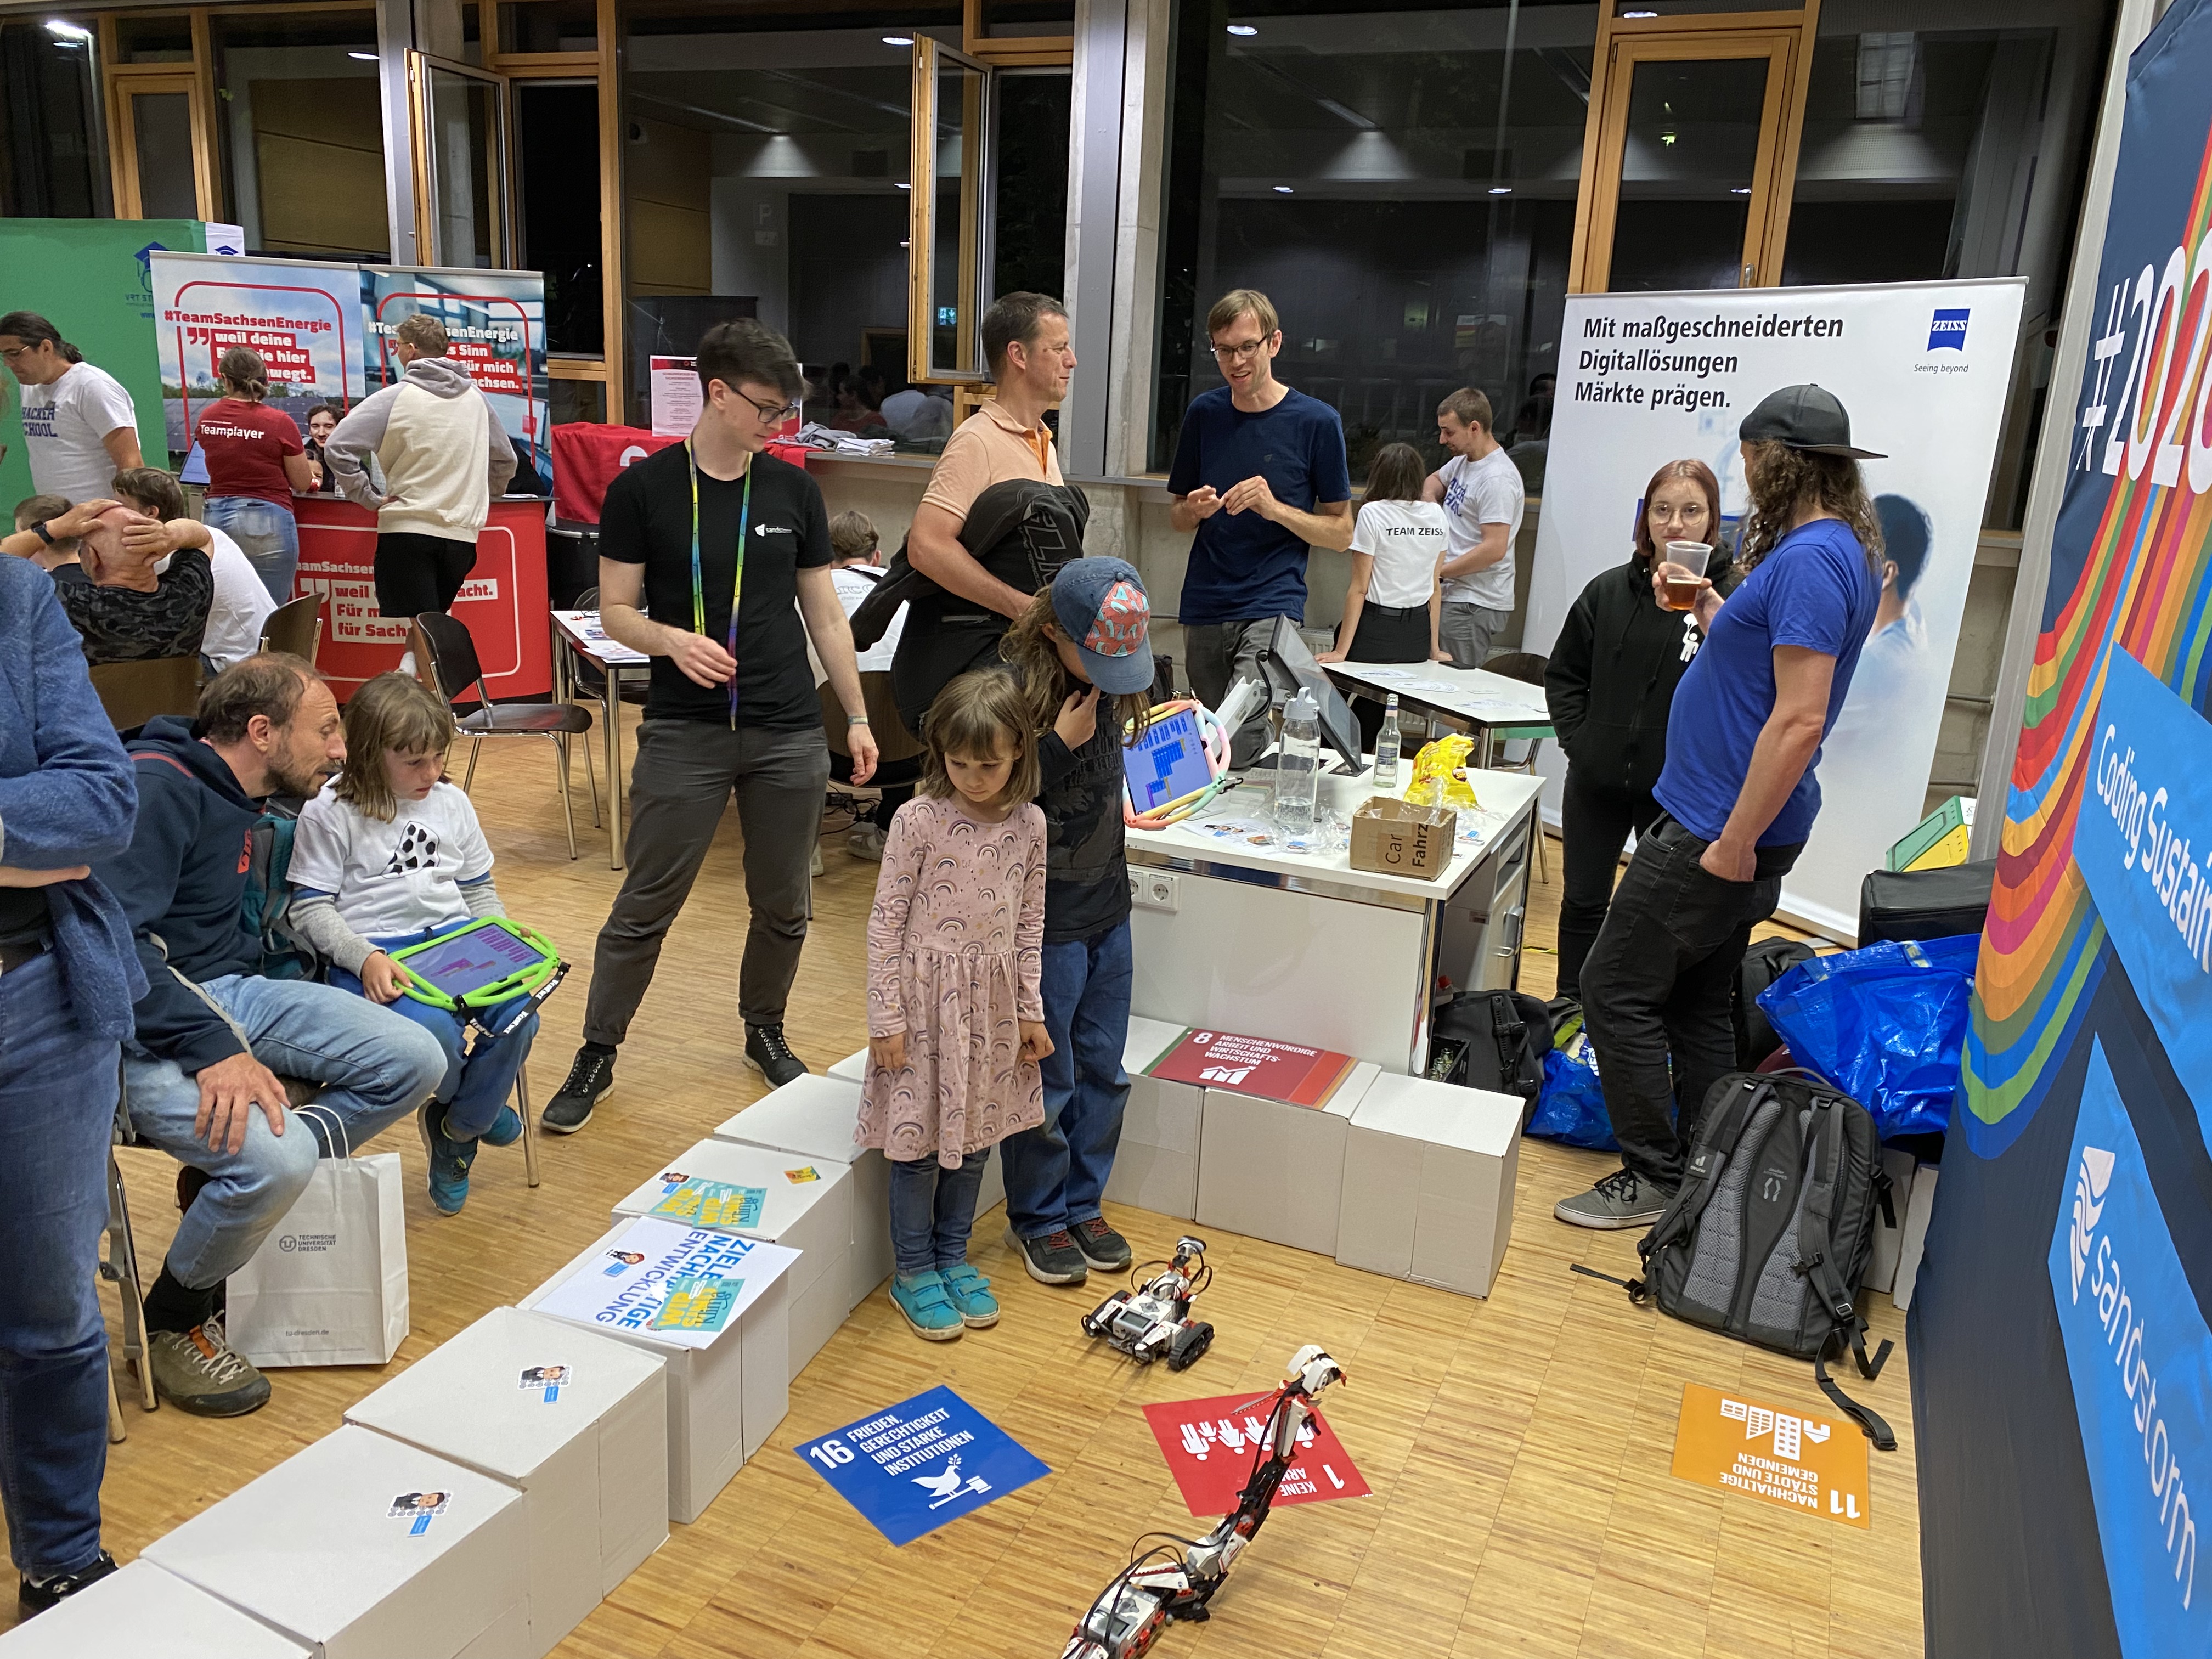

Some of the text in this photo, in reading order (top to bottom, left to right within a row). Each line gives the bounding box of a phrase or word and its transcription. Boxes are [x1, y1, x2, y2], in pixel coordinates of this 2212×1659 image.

[164, 310, 331, 332] #TeamSachsenEnergie
[368, 321, 518, 342] #TeasenEnergie
[1584, 314, 1843, 345] Mit maßgeschneiderten
[1933, 319, 1967, 332] ZEISS
[215, 331, 292, 346] weil deine
[276, 350, 306, 364] hier
[459, 344, 488, 357] Sinn
[483, 360, 514, 374] mich
[1579, 350, 1738, 378] Digitallösungen
[1914, 364, 1968, 374] Seeing beyond
[473, 376, 520, 390] achsen.
[1575, 382, 1730, 412] Märkte prägen.
[22, 422, 58, 437] CHOOL
[200, 425, 264, 439] Teamplayer
[1386, 527, 1443, 536] TEAM ZEISS
[335, 585, 369, 599] weil
[457, 583, 493, 598] acht.
[337, 603, 363, 617] Für
[338, 622, 361, 636] für
[2097, 724, 2147, 870] Coding
[1385, 834, 1402, 864] Car
[1193, 1032, 1213, 1044] 8
[1214, 1041, 1271, 1054] ARBEIT UND
[1220, 1035, 1317, 1057] MENSCHENWÜRDIGE
[1204, 1052, 1261, 1065] WACHSTUM
[1210, 1046, 1281, 1062] WIRTSCHAFTS-
[596, 1231, 709, 1323] ENTWICKLUNG
[846, 1414, 903, 1443] FRIEDEN,
[859, 1408, 950, 1453] GERECHTIGKEIT
[2092, 1235, 2197, 1611] sandstorm
[810, 1440, 855, 1469] 16
[871, 1426, 947, 1464] UND STARKE
[883, 1430, 975, 1476] INSTITUTIONEN
[1322, 1464, 1345, 1489] 1
[1738, 1452, 1818, 1483] GEMEINDEN
[1278, 1481, 1317, 1496] KEINE
[1733, 1463, 1818, 1496] STÄDTE UND
[1719, 1472, 1818, 1509] NACHHALTIGE
[1830, 1489, 1860, 1519] 11
